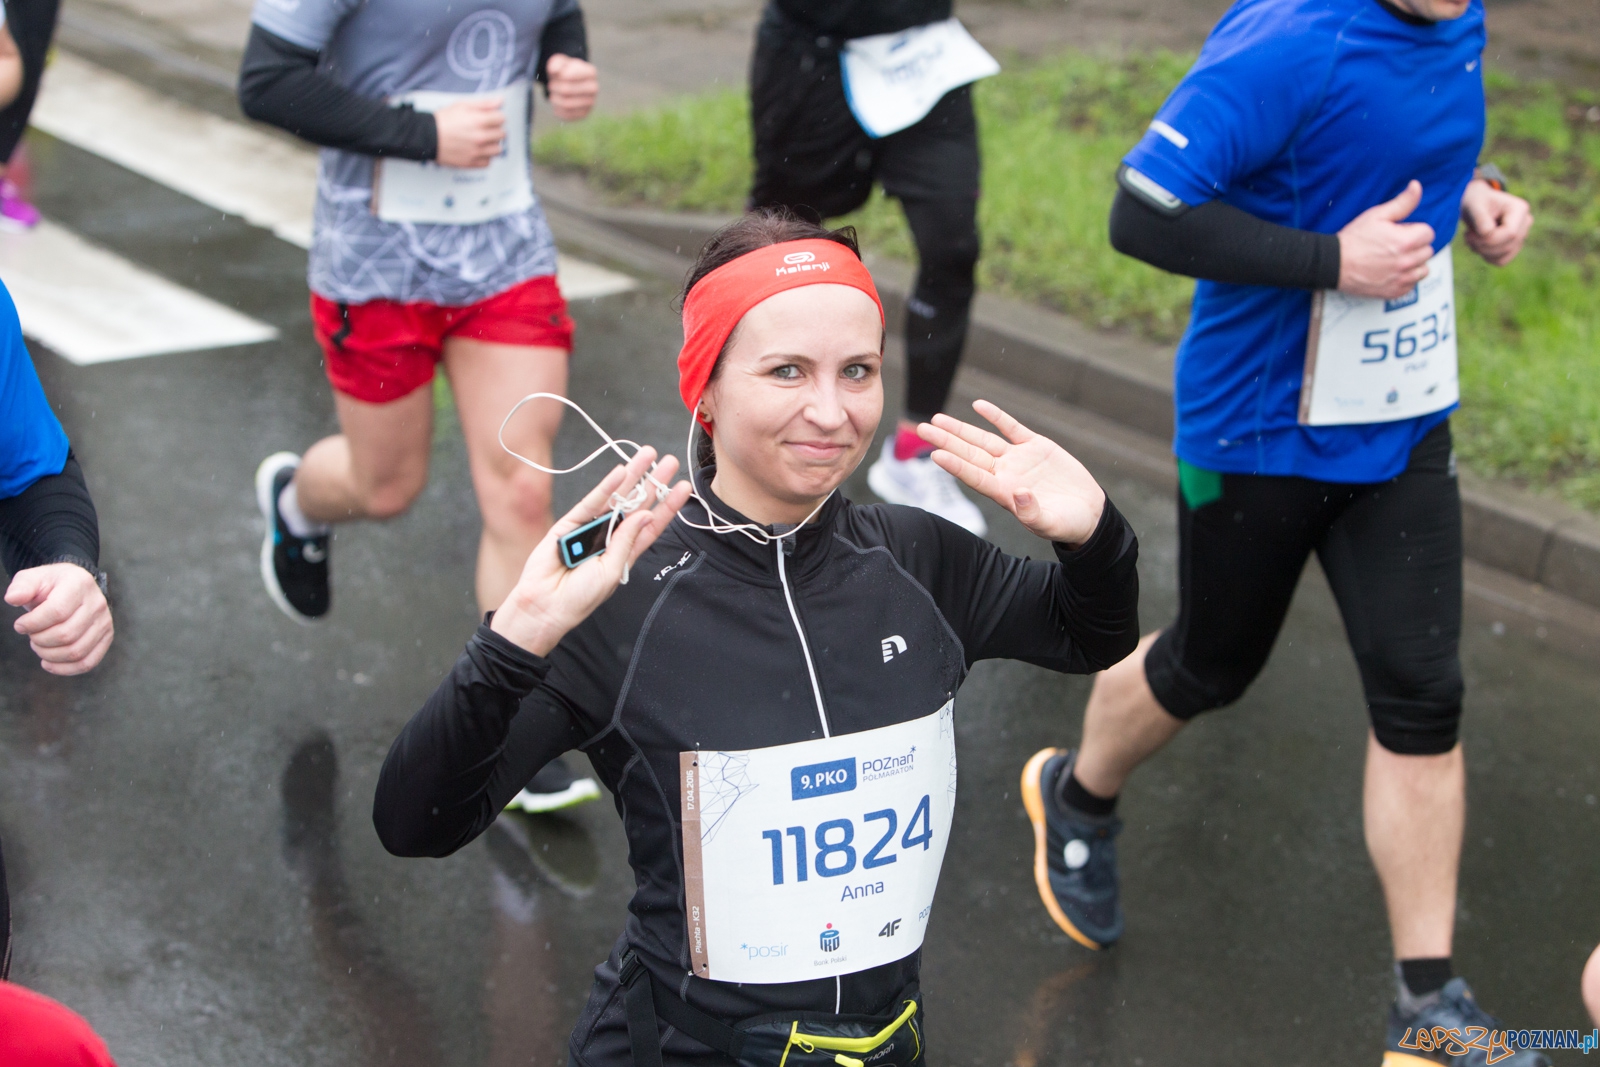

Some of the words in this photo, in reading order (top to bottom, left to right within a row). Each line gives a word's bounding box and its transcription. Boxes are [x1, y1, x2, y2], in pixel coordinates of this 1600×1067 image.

[775, 261, 831, 277] Kalenji
[815, 768, 848, 788] PKO
[687, 770, 695, 810] 17.04.2016
[762, 794, 933, 885] 11824
[841, 881, 884, 902] Anna
[878, 918, 902, 938] 4F
[830, 956, 848, 965] Polski
